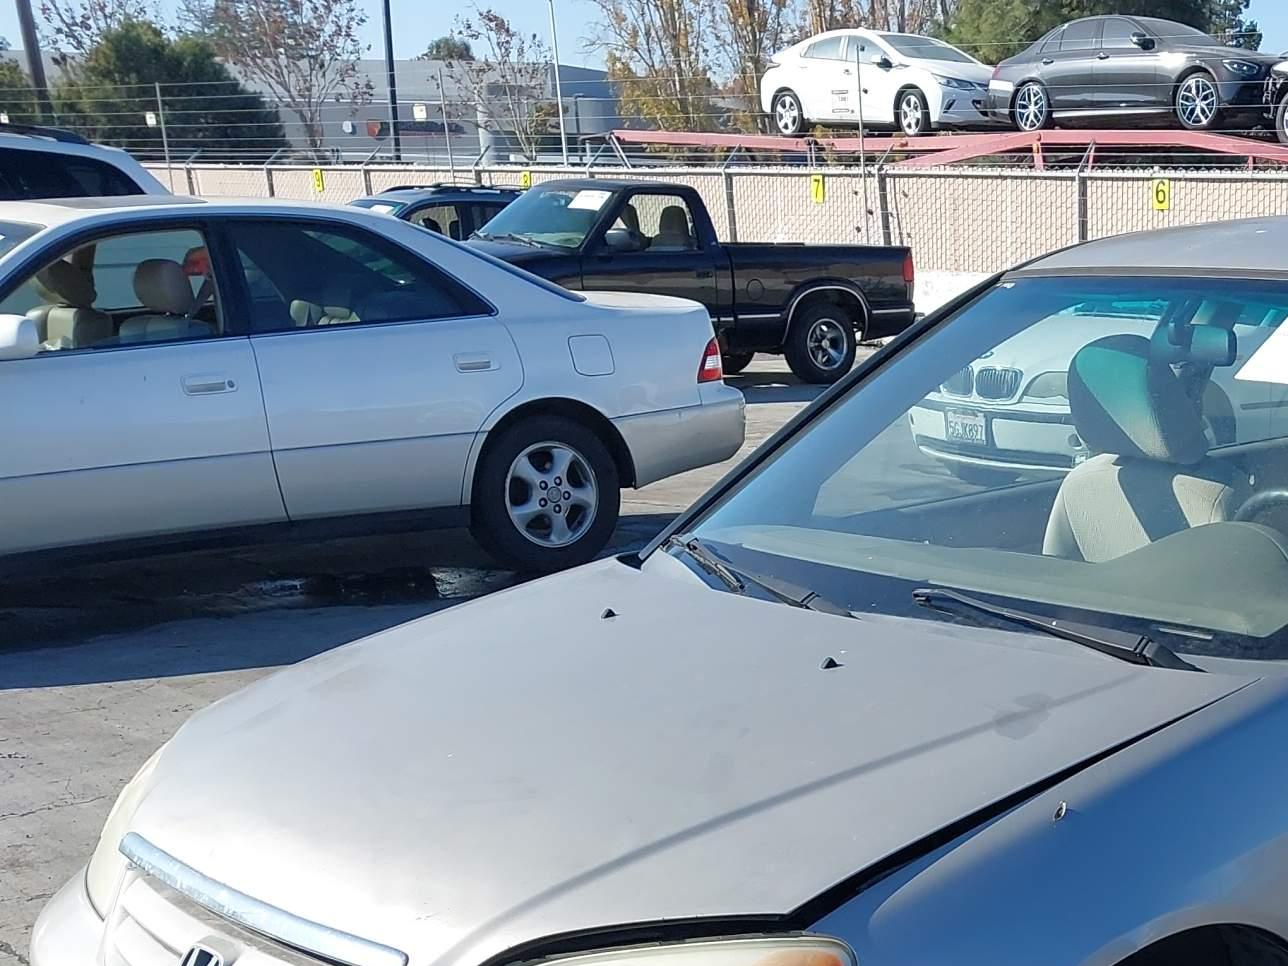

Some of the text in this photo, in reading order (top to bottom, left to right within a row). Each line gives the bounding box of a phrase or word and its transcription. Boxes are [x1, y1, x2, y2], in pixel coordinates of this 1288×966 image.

[314, 170, 321, 188] 9
[813, 178, 821, 199] 7
[1155, 180, 1166, 204] 6
